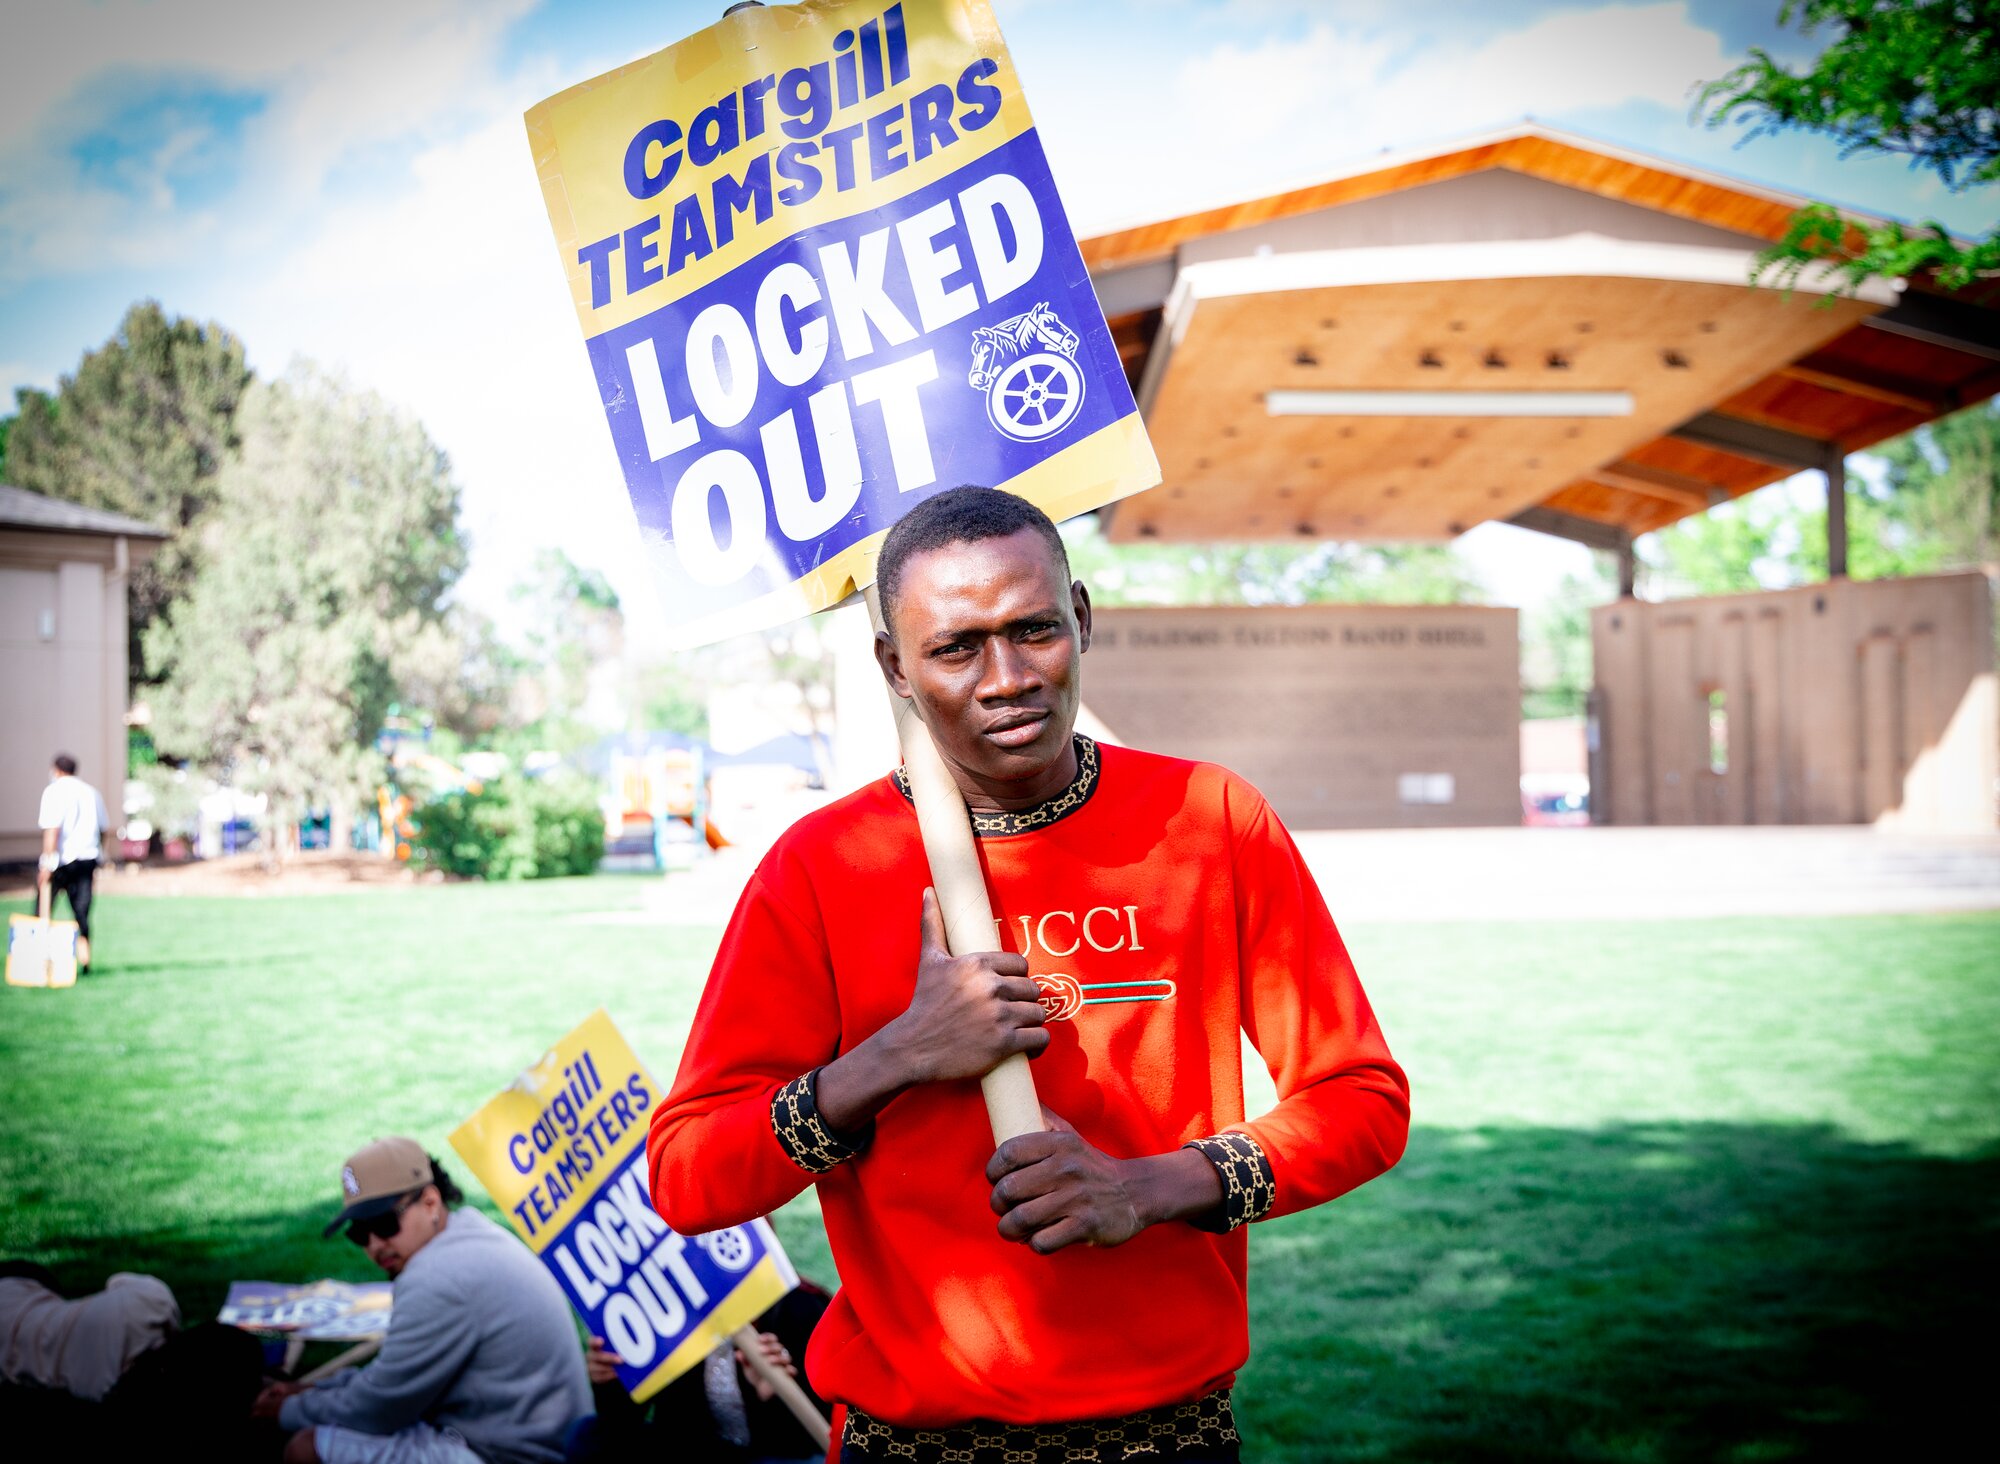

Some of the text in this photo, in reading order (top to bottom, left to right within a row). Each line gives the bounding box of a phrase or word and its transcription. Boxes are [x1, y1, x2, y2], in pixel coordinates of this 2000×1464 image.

[623, 3, 910, 200] Cargill
[578, 58, 1002, 310] TEAMSTERS
[625, 173, 1045, 462] LOCKED
[671, 349, 939, 587] OUT
[994, 905, 1145, 958] UCCI
[508, 1050, 603, 1175] Cargill
[513, 1073, 651, 1236] TEAMSTERS
[553, 1153, 669, 1311] LOCK
[603, 1232, 709, 1369] OUT
